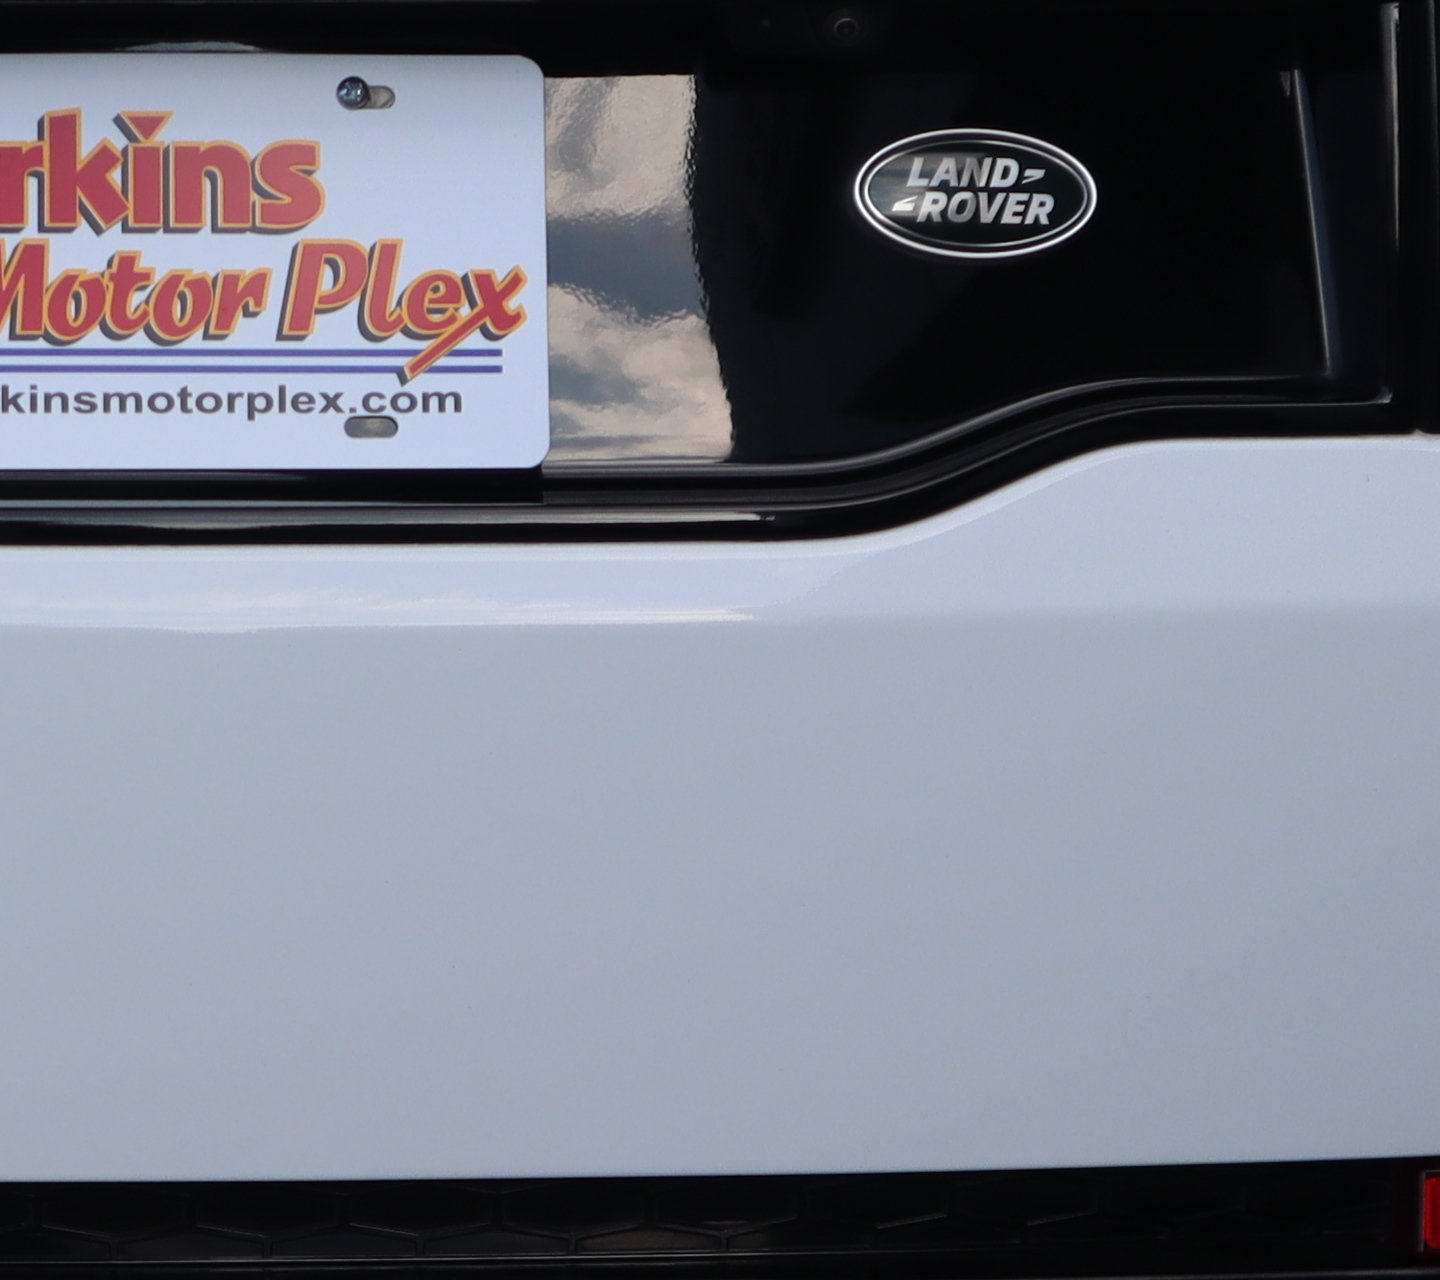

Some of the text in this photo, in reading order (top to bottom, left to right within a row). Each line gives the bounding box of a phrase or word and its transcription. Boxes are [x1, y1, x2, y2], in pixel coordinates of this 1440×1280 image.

[906, 156, 1021, 188] LAND
[916, 190, 1056, 226] ROVER
[276, 236, 528, 386] Plex
